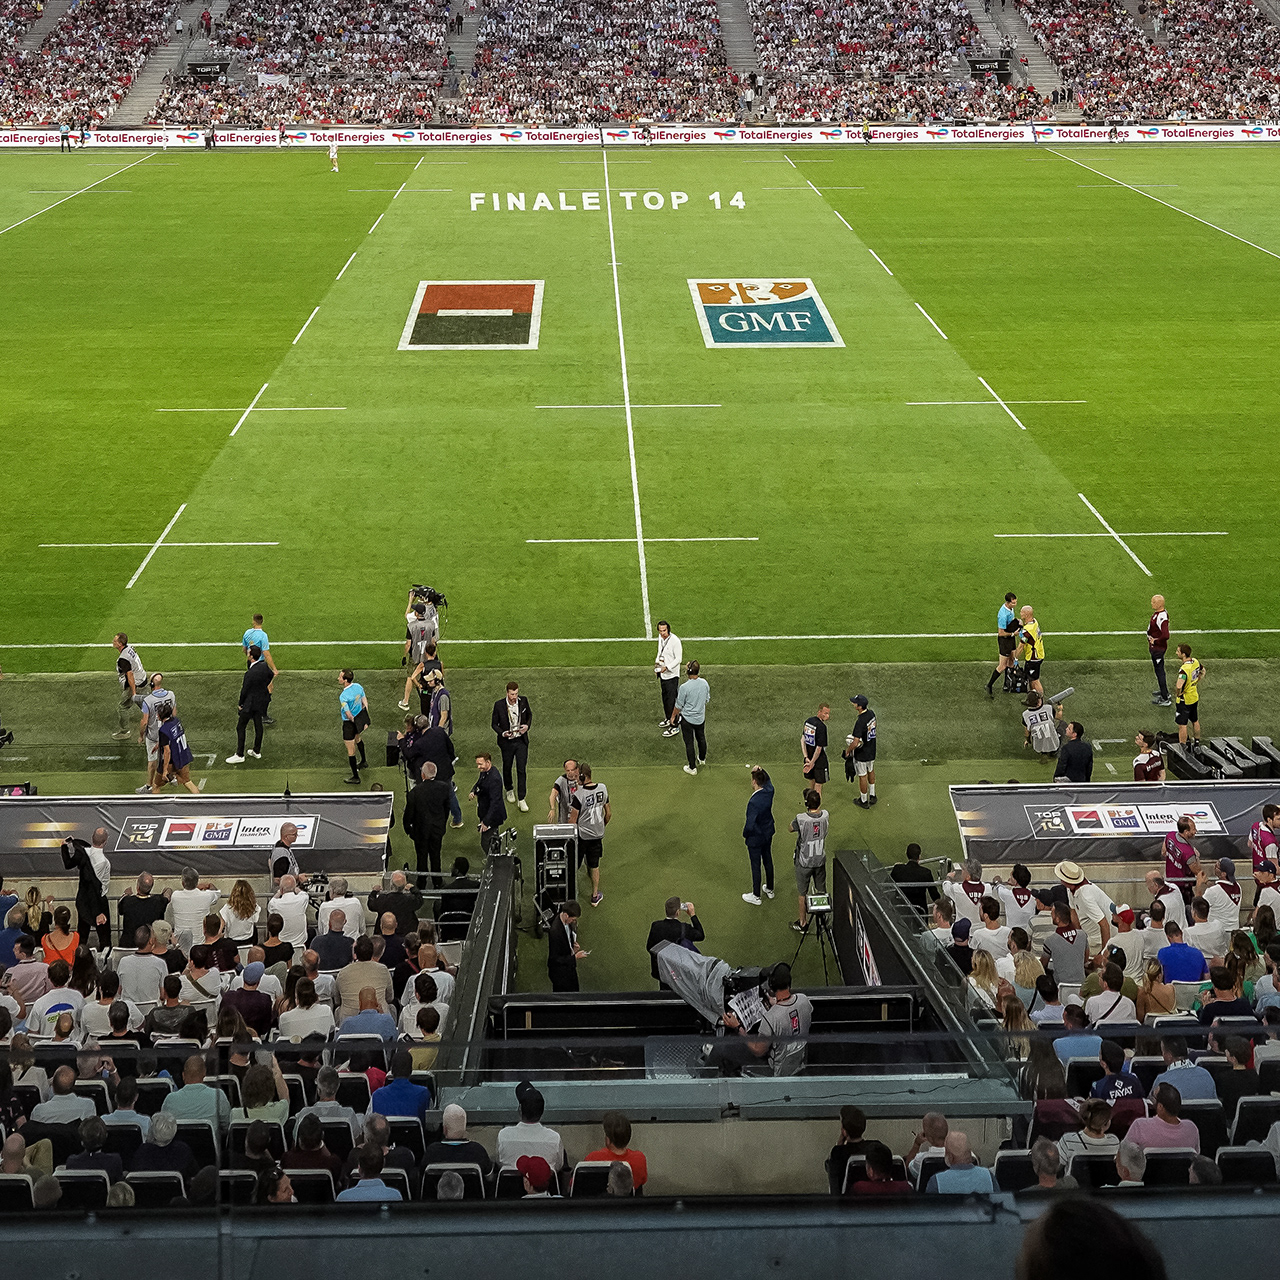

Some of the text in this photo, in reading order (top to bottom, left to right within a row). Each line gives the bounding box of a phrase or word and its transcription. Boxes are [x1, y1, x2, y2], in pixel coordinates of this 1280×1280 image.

[310, 133, 385, 144] TotalEnergies
[418, 132, 492, 143] TotalEnergies
[526, 132, 600, 143] TotalEnergies
[739, 131, 812, 141] TotalEnergies
[951, 130, 1024, 140] TotalEnergies
[1162, 129, 1234, 139] TotalEnergies
[470, 192, 746, 211] FINALE TOP 14
[718, 312, 812, 332] GMF
[1145, 813, 1176, 822] Inter
[1113, 819, 1137, 828] GMF
[205, 832, 230, 840] GMF
[242, 826, 271, 836] Inter
[807, 839, 824, 857] TV
[1110, 1086, 1133, 1099] FAYAT
